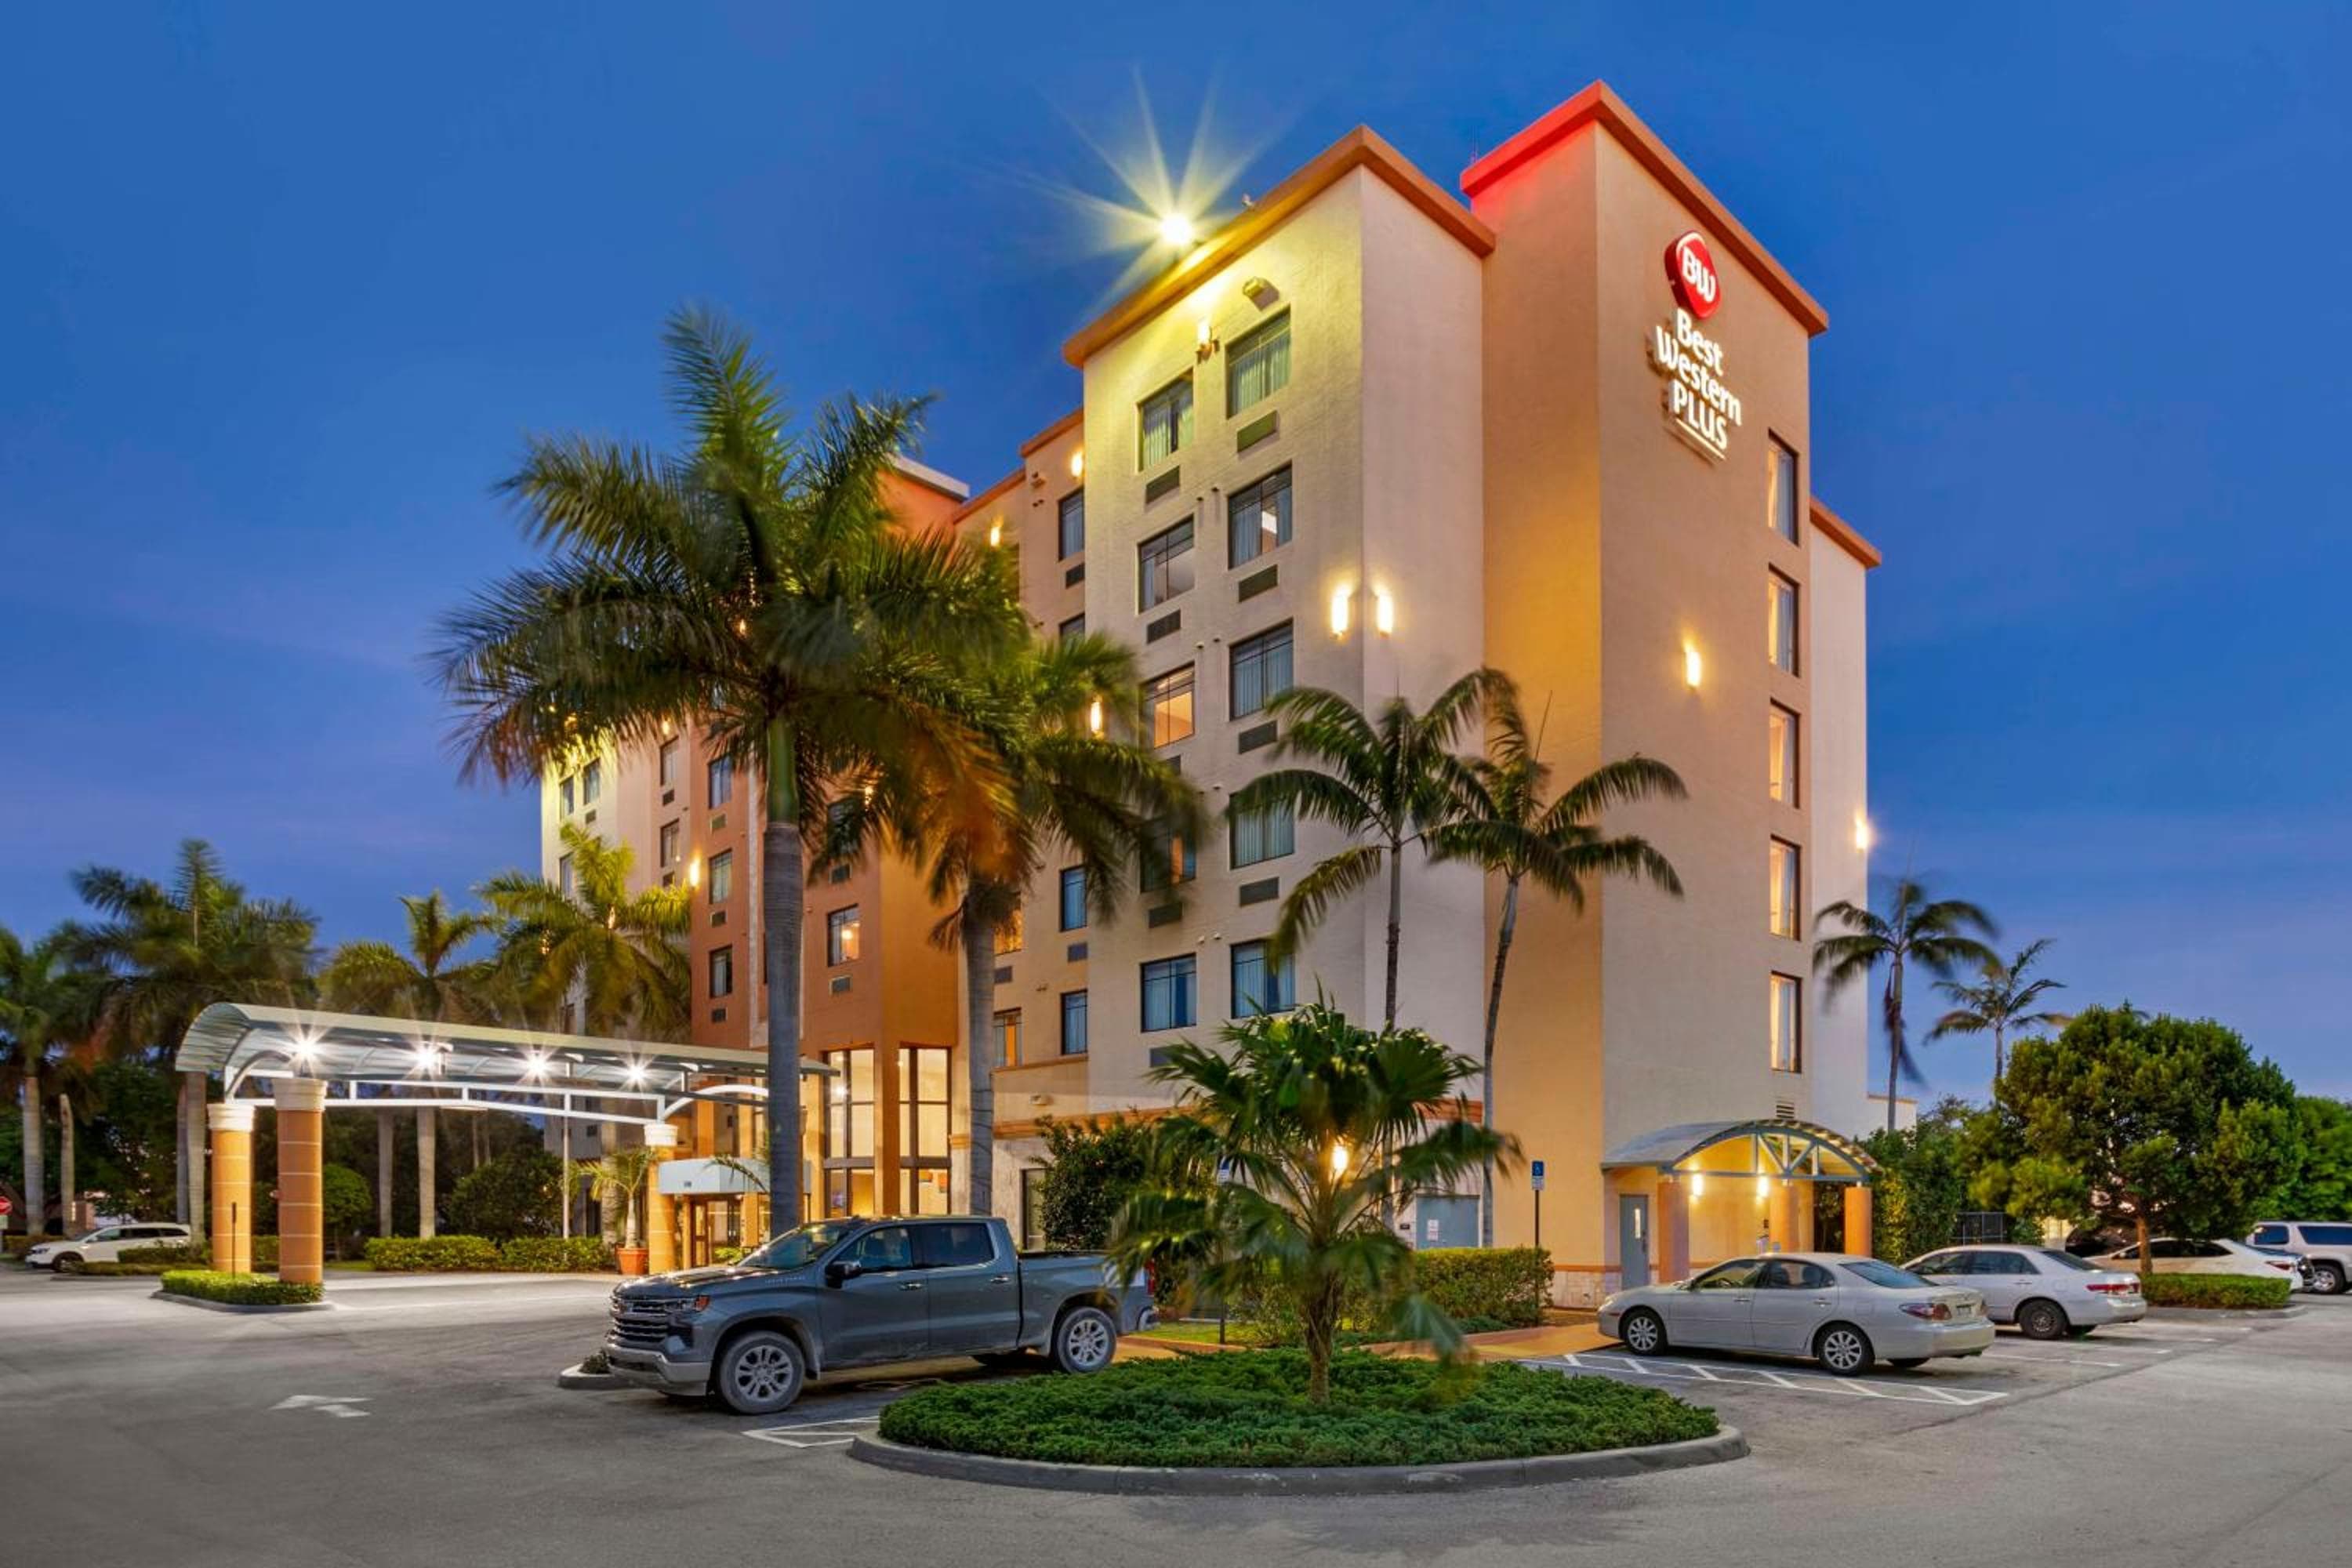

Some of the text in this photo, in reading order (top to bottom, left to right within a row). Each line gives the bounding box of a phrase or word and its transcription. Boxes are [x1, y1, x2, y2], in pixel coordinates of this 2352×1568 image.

[1682, 245, 1716, 303] BW
[1655, 325, 1742, 427] Western
[1676, 307, 1724, 377] Best
[1671, 379, 1727, 450] PLUS
